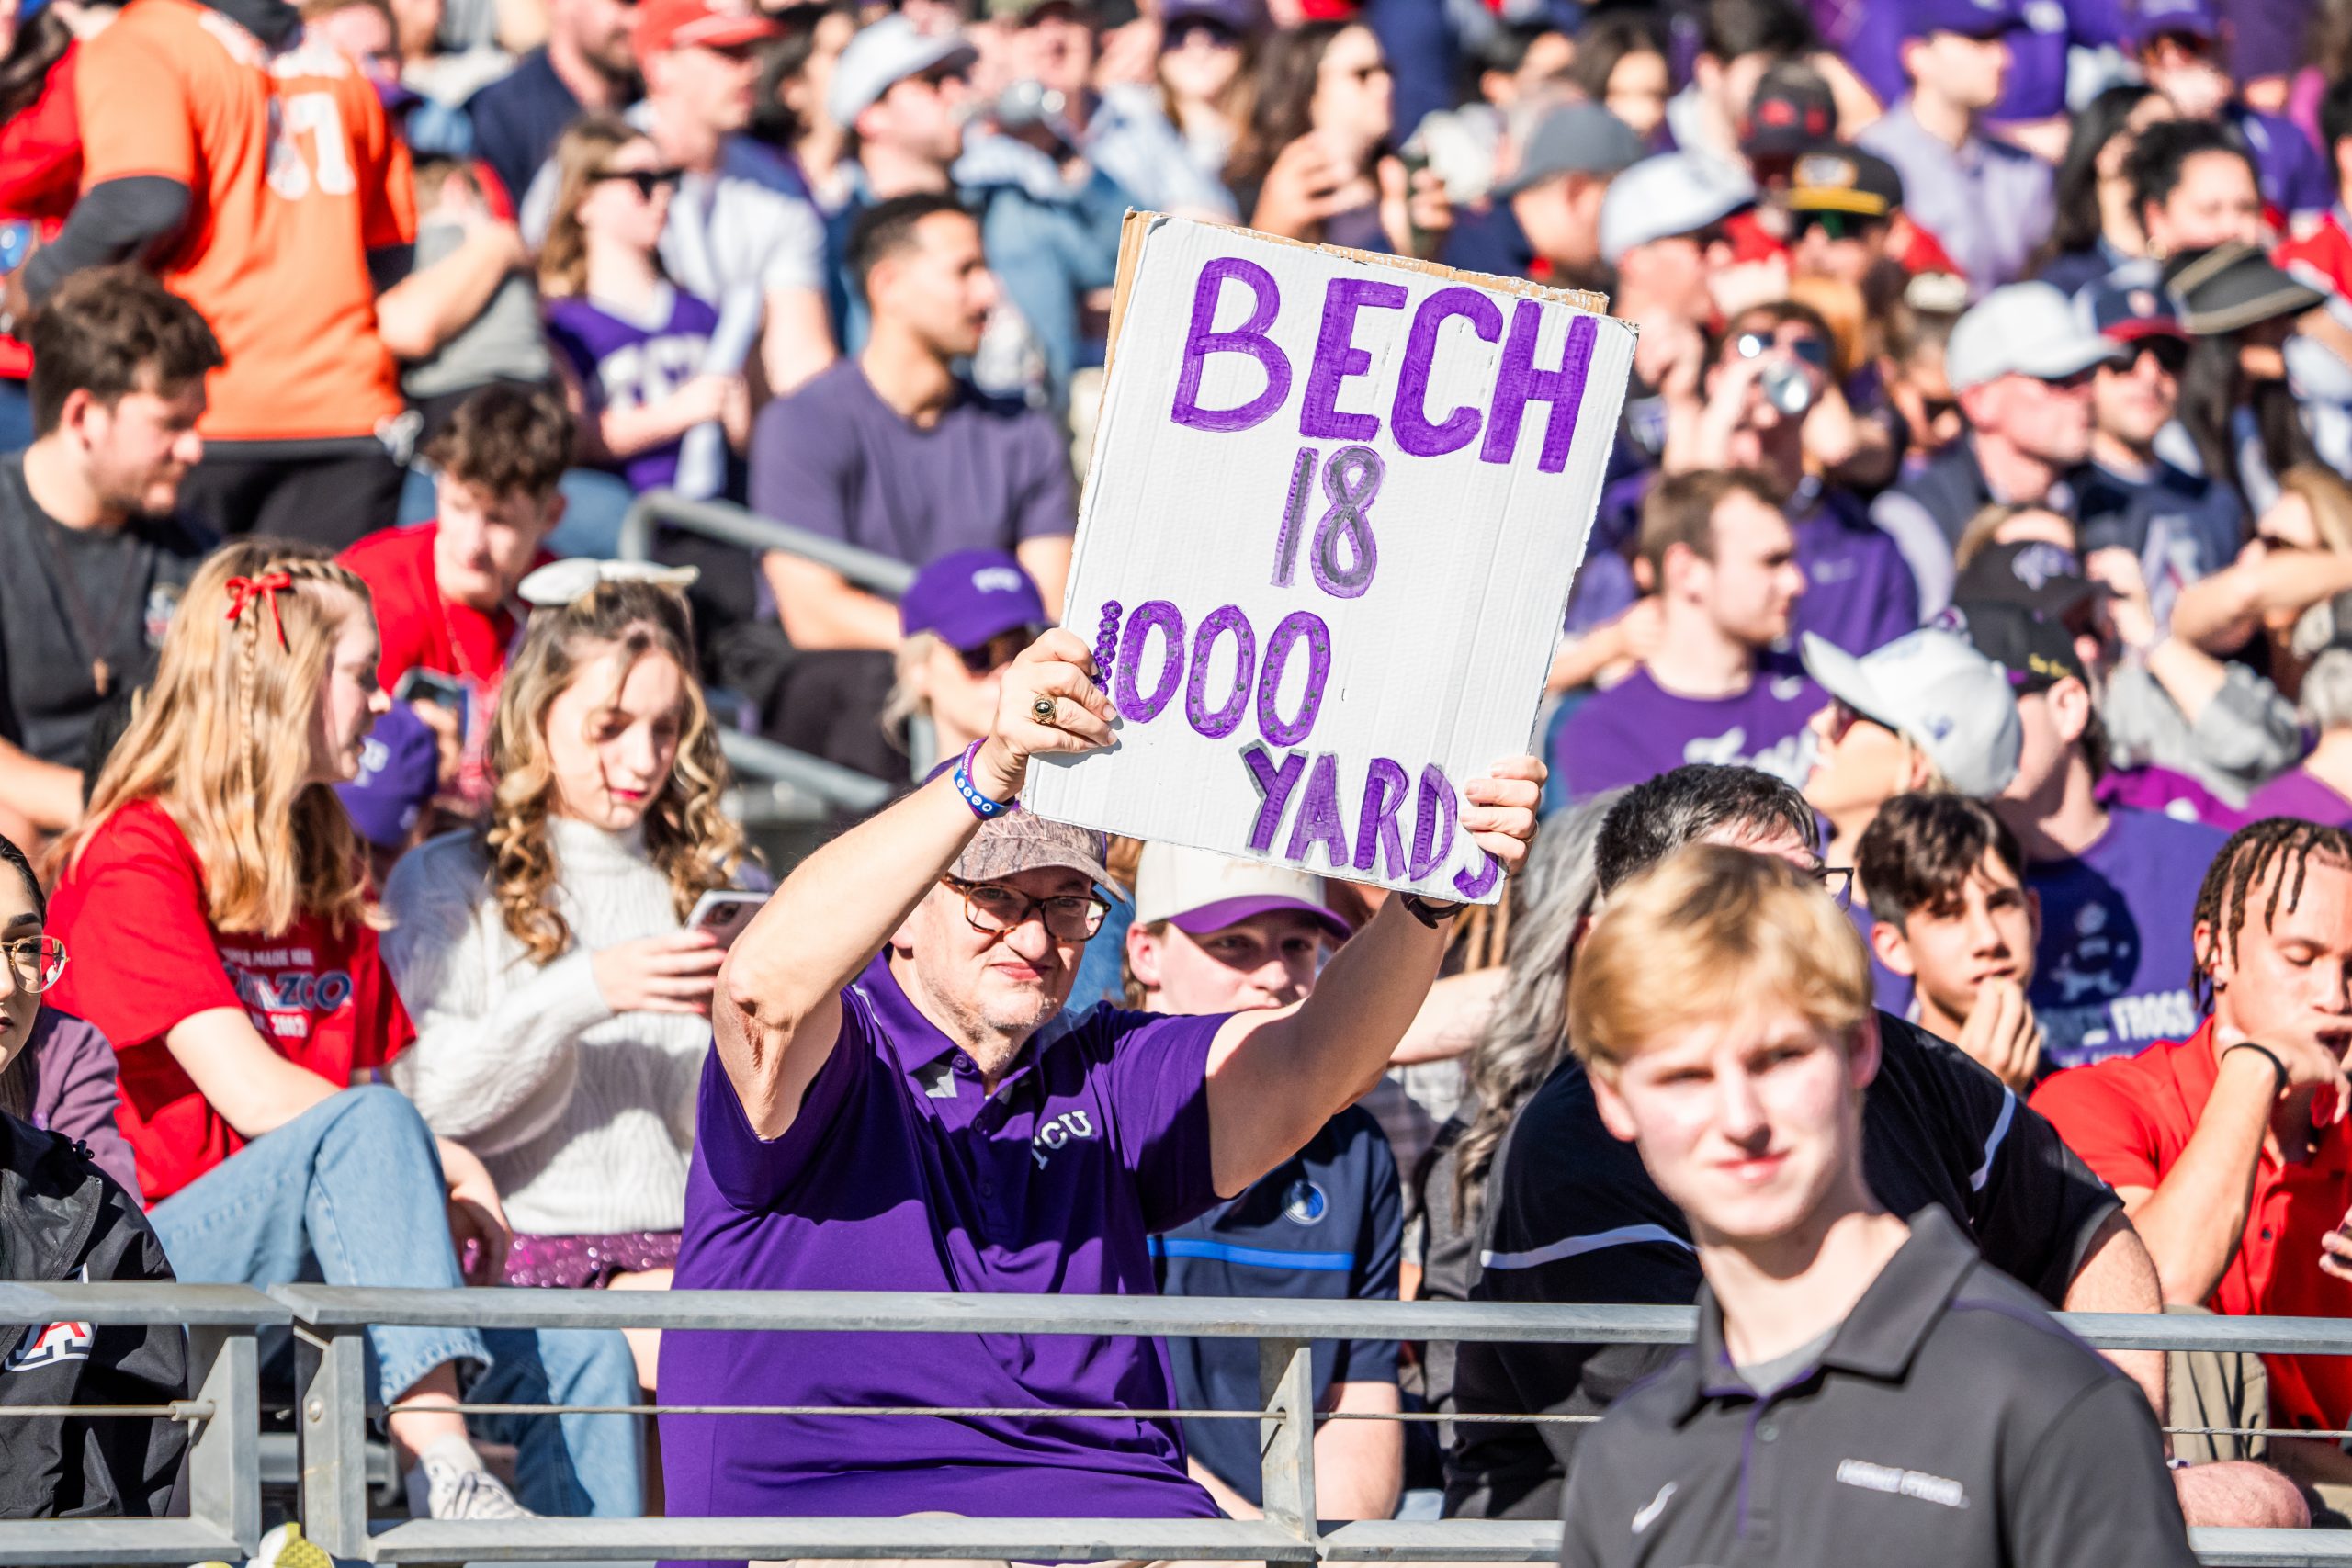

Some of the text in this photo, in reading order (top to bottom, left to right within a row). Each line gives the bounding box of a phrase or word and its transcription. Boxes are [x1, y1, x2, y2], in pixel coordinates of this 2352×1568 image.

[1170, 256, 1600, 474] BECH
[1270, 445, 1387, 599] 18
[1092, 599, 1332, 748] 1000
[2109, 988, 2197, 1042] FROGS
